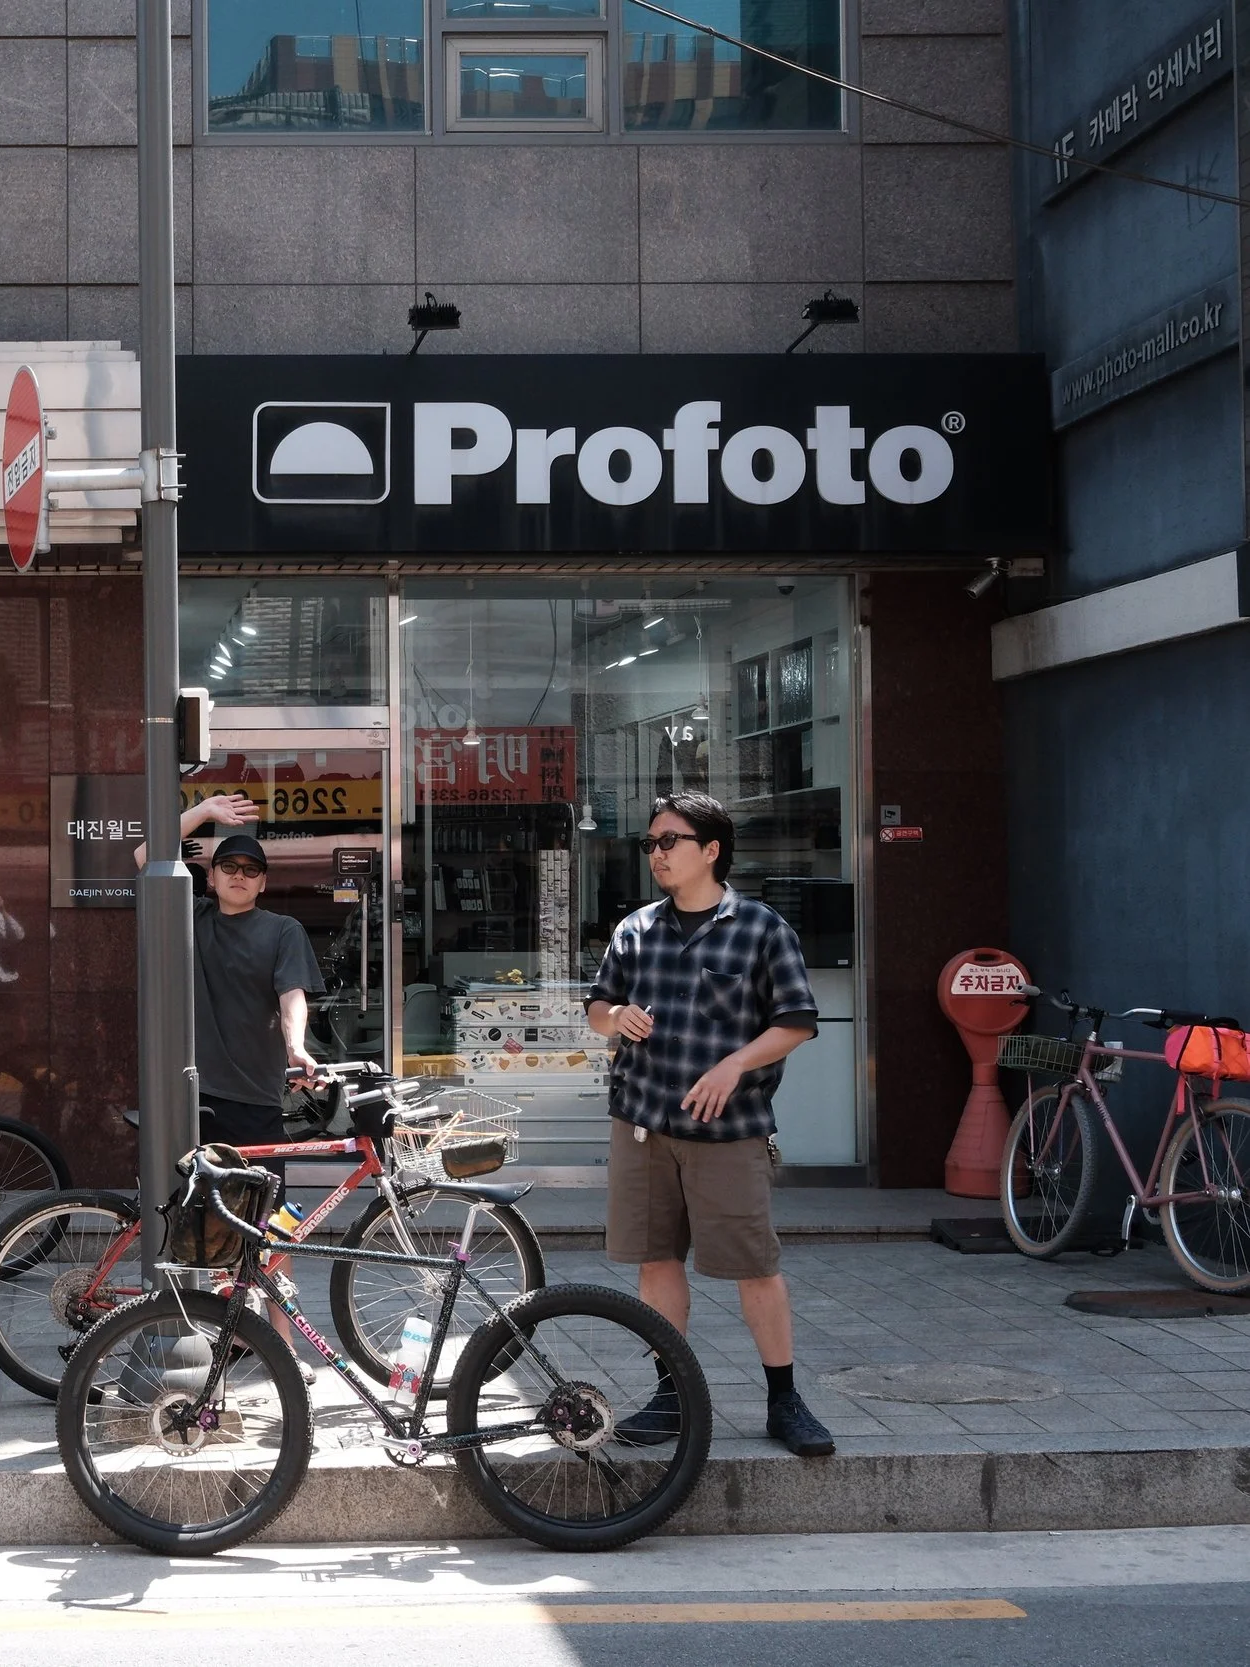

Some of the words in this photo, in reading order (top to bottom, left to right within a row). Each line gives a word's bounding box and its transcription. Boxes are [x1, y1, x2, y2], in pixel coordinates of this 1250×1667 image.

[1088, 84, 1141, 148] 카메라
[1146, 18, 1224, 100] 악세사리
[1061, 301, 1225, 406] www.photo-mall.co.kr
[6, 440, 37, 497] 진입금지
[67, 819, 145, 840] 대진월드
[69, 888, 102, 898] DAEJIN
[104, 888, 136, 898] WORL
[959, 975, 1020, 992] 주차금지
[294, 1186, 350, 1242] Panasonic
